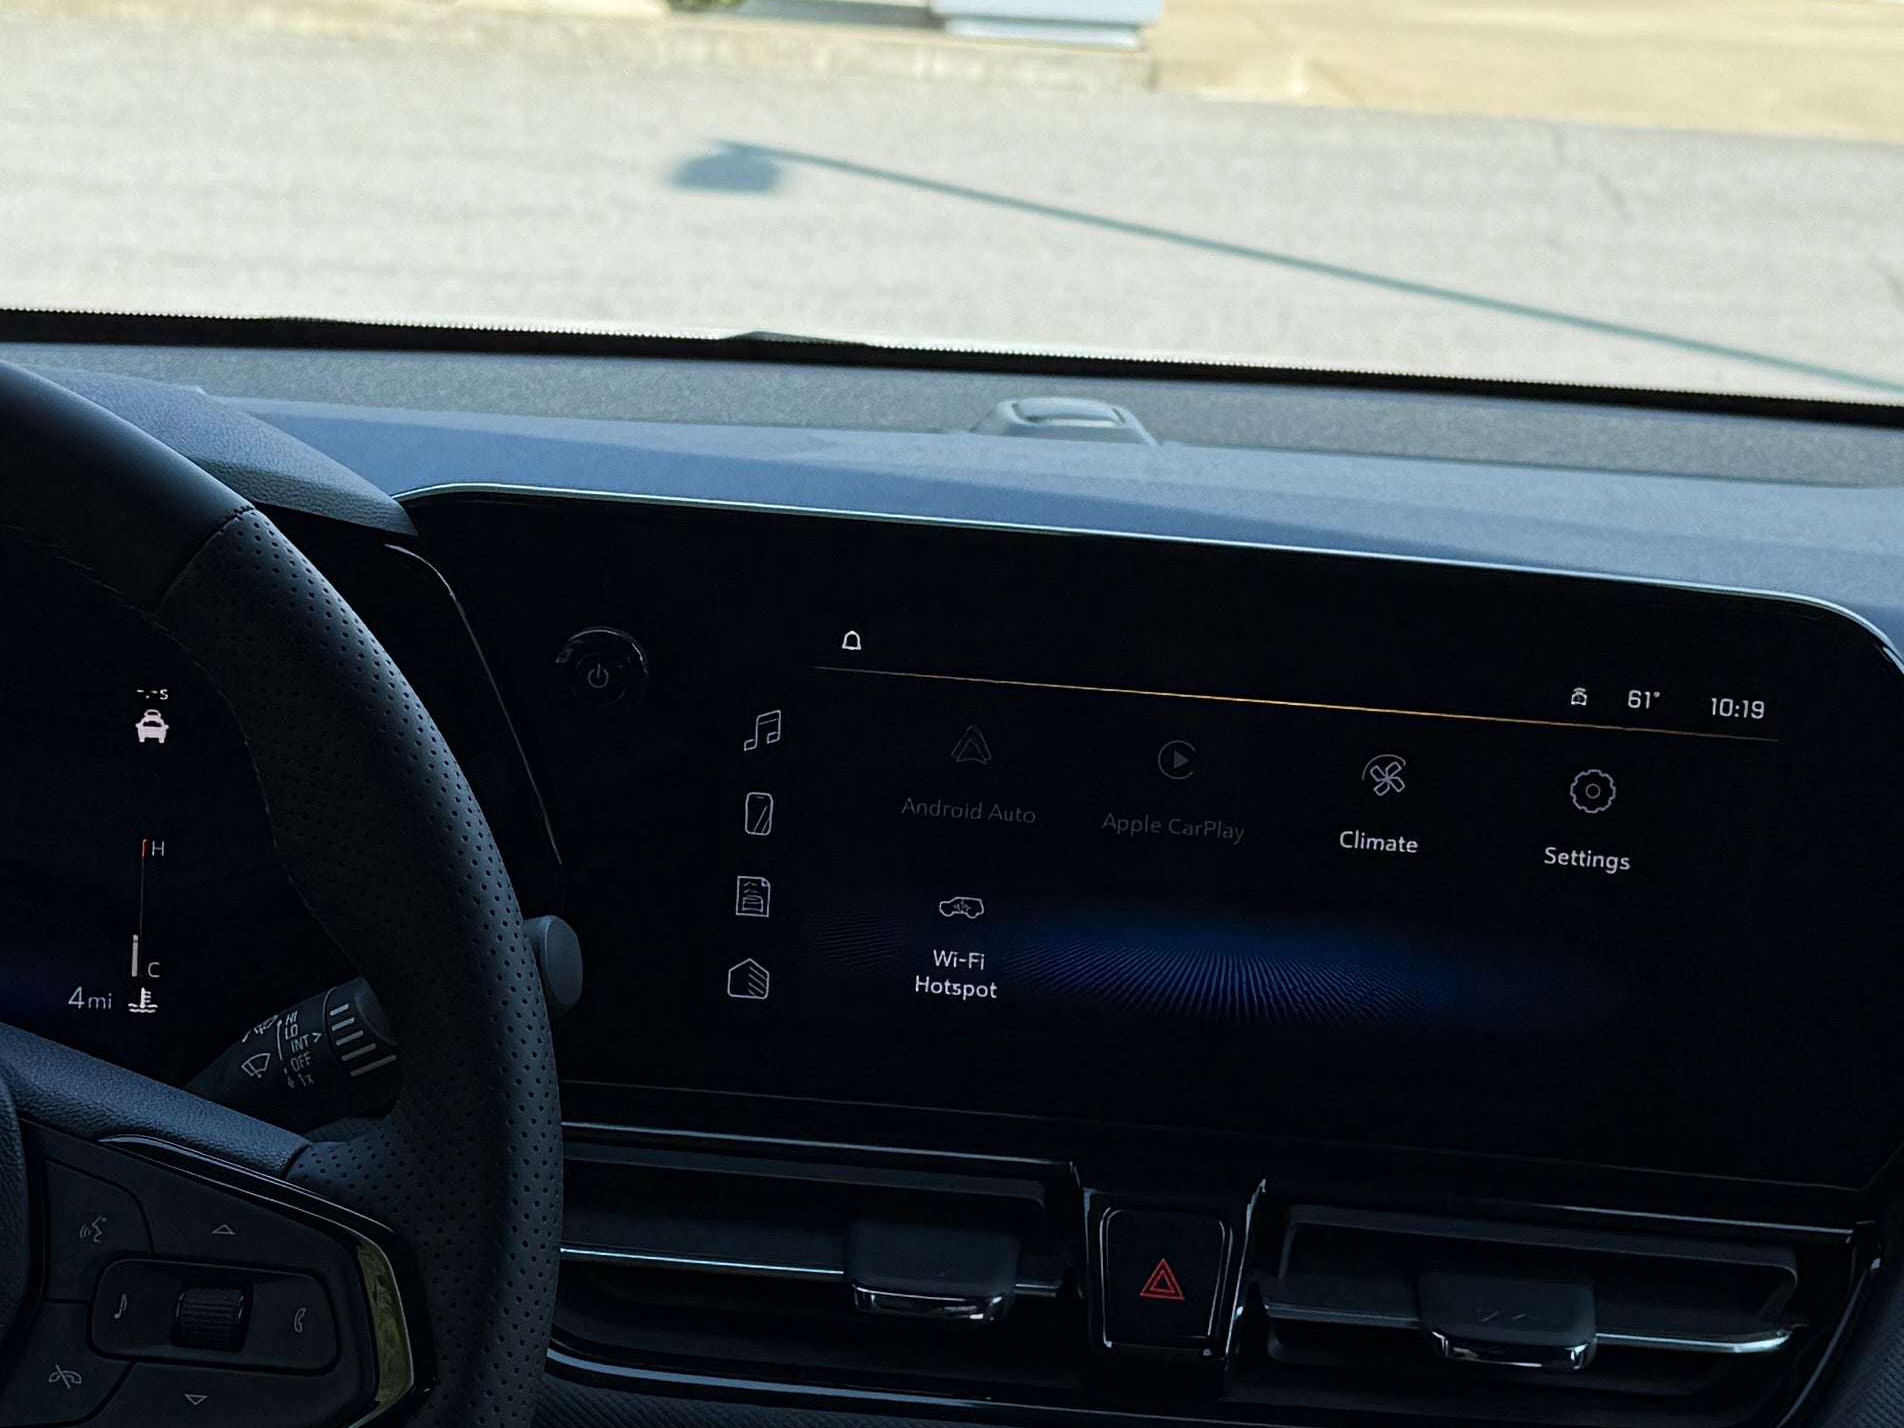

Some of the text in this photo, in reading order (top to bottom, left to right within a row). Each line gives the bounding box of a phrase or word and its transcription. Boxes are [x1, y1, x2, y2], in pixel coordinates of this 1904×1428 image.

[1711, 697, 1765, 720] 10:19
[900, 797, 1037, 824] Android Auto
[1100, 812, 1246, 846] Apple CarPlay
[152, 840, 165, 857] H
[1339, 829, 1419, 854] Climate
[1544, 846, 1631, 875] Settings
[148, 961, 161, 979] C
[933, 948, 985, 971] Wi-Fi
[915, 975, 998, 1001] Hotspot
[290, 1033, 310, 1054] INT
[290, 1051, 311, 1073] OFF
